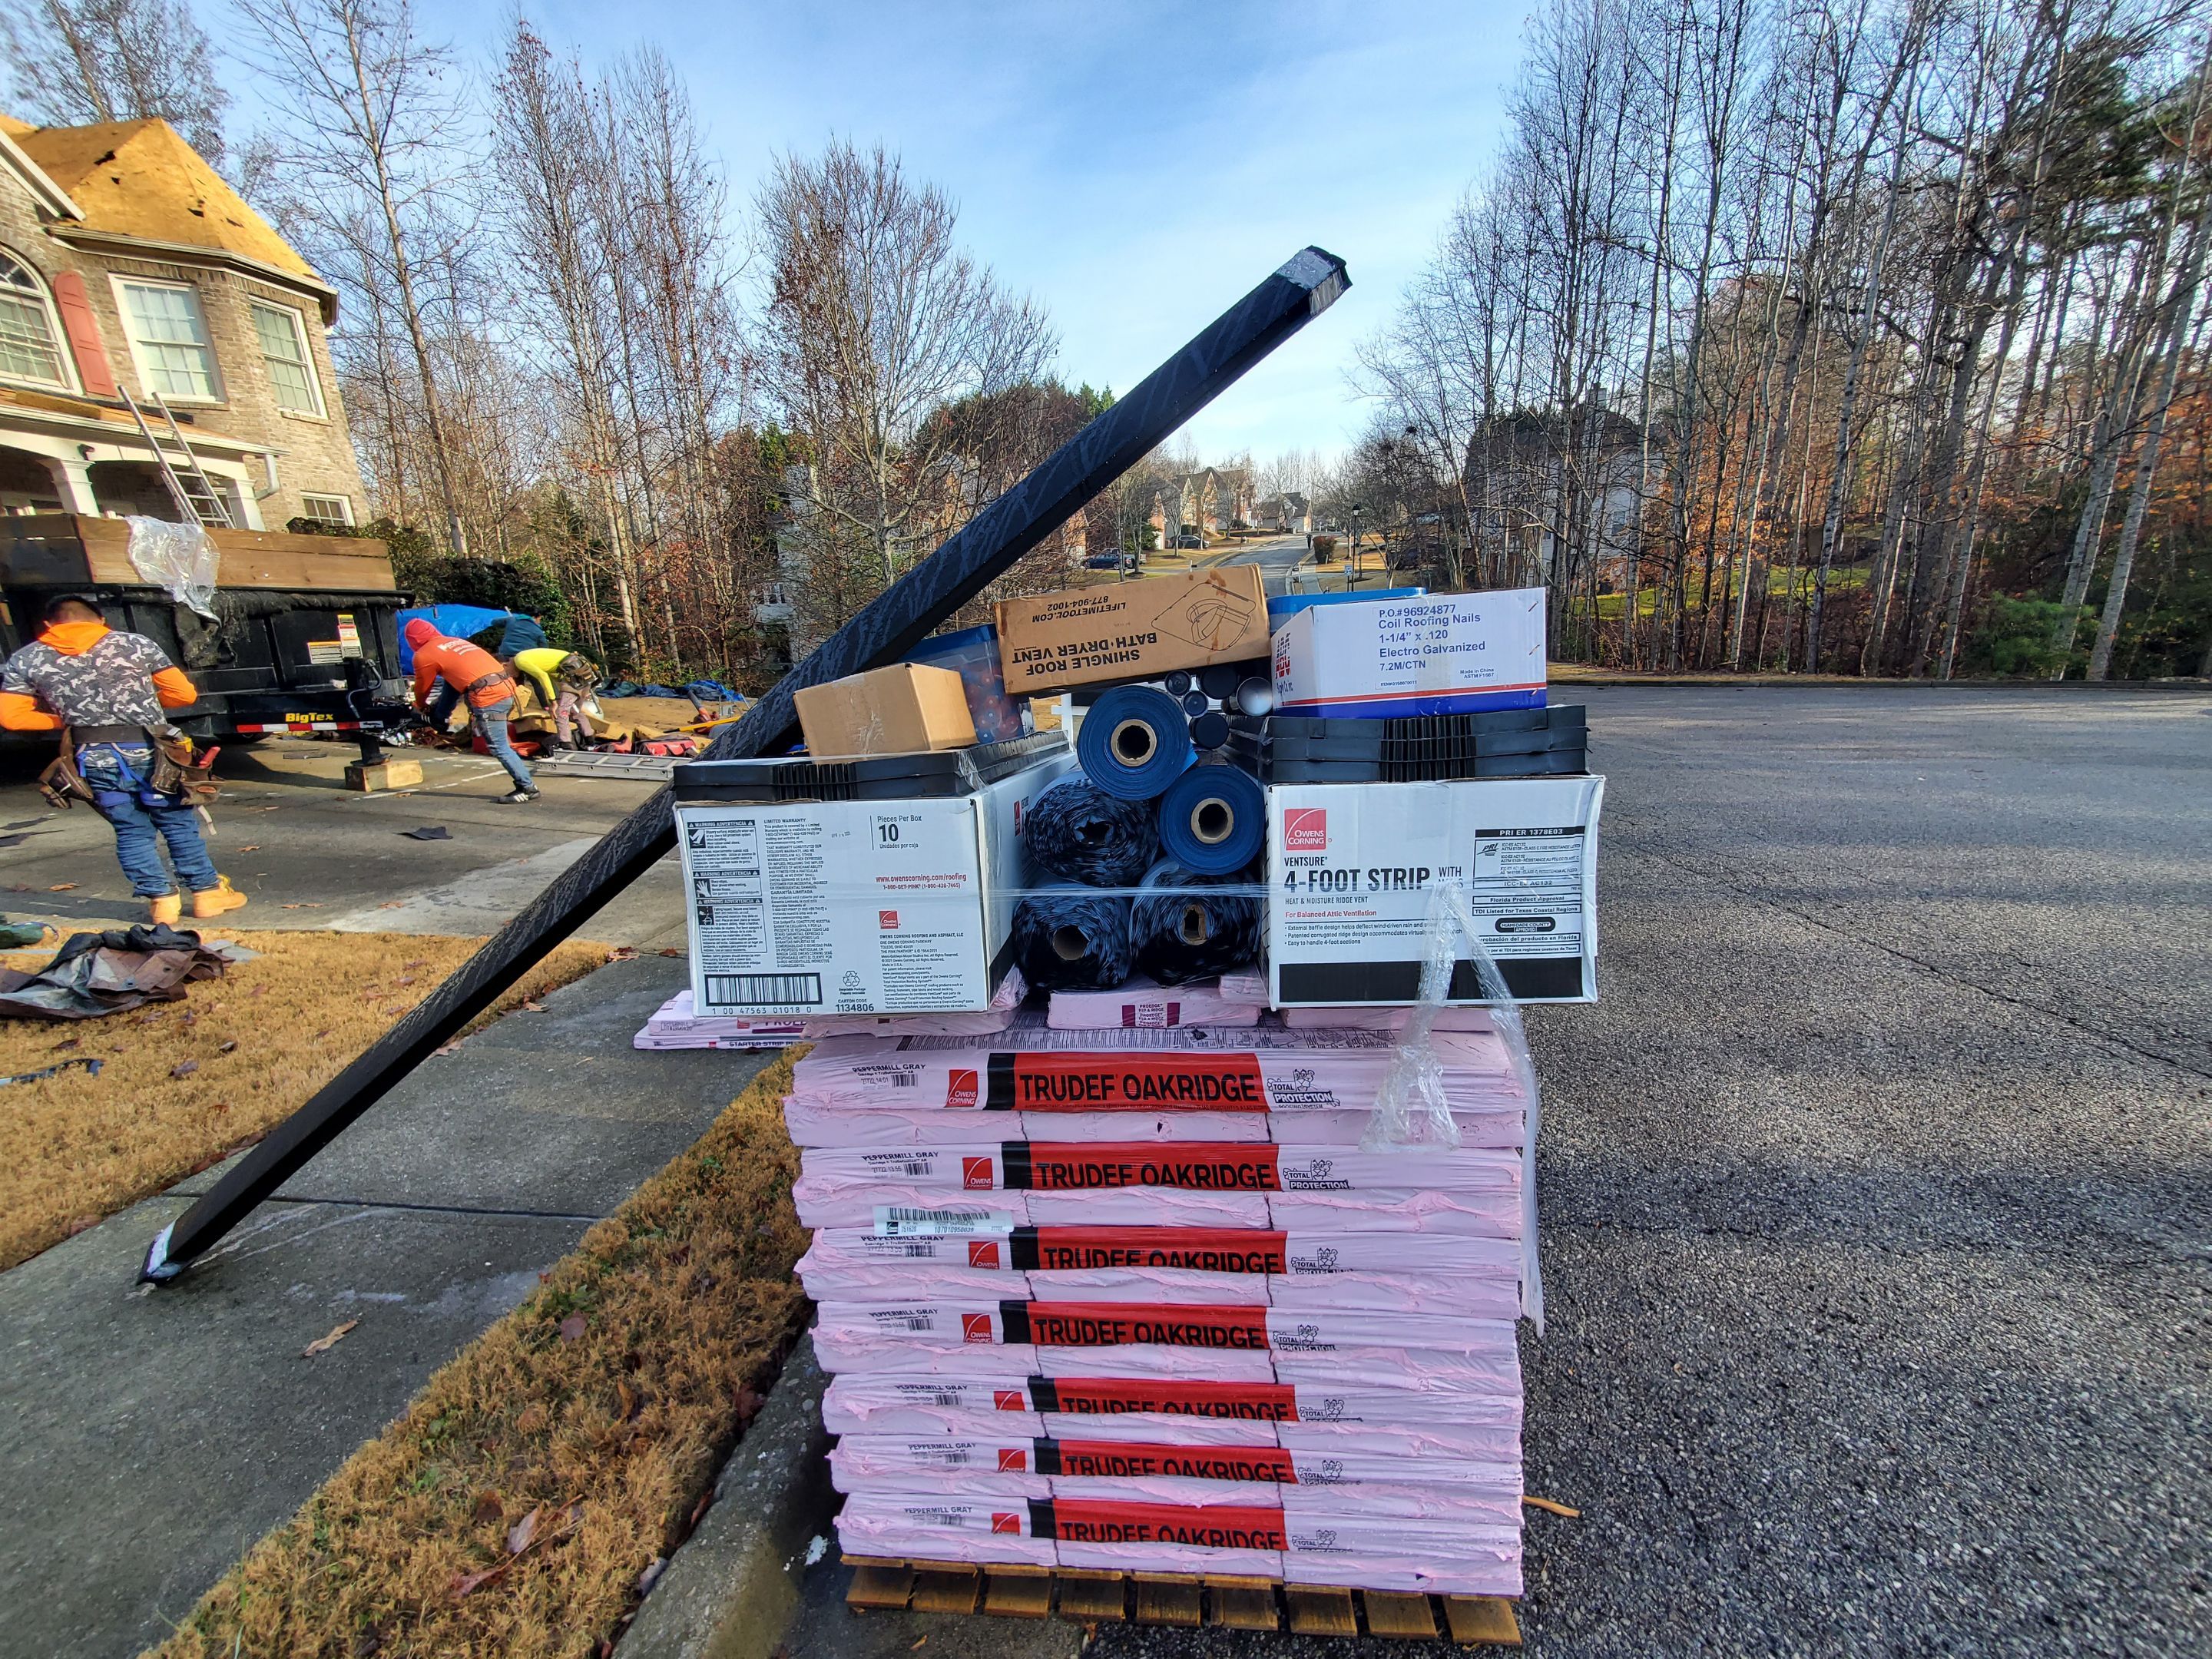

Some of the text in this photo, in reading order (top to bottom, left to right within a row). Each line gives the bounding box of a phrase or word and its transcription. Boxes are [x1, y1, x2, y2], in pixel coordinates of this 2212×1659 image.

[1048, 596, 1109, 611] 877-904-1002
[1379, 604, 1455, 618] P.O.#96924877
[1379, 613, 1481, 629] Coil Roofing Nails
[1426, 630, 1448, 640] .120
[1012, 632, 1157, 664] BATH DRYER VENT
[1379, 641, 1485, 657] Electro Galvanized
[1026, 650, 1140, 676] SHINGLE ROOF
[1380, 661, 1426, 671] 7.2M/CTN
[286, 713, 333, 724] BigTex
[879, 823, 899, 842] 10
[876, 873, 967, 882] www.owenscorning.com/roofing
[1284, 869, 1361, 893] 4-FOOT
[1368, 868, 1430, 891] STRIP
[1439, 866, 1462, 877] WITH
[836, 1003, 874, 1012] 1134806
[853, 1065, 902, 1073] PEPPERMILL
[1019, 1074, 1260, 1102] TRUDEF OAKRIDGE
[1275, 1092, 1332, 1103] PROTECTION
[862, 1153, 916, 1161] PEPPERMILL
[1037, 1163, 1274, 1189] TRUDEF OAKRIDGE
[1290, 1181, 1349, 1190] PROTECTION
[1044, 1247, 1280, 1274] TRUDEF OAKRIDGE
[1035, 1319, 1263, 1349] TRUDEF OAKRIDGE
[1066, 1456, 1291, 1484] TRUDEF OAKRIDGE
[1061, 1522, 1281, 1550] TRUDEF OAKRIDGE
